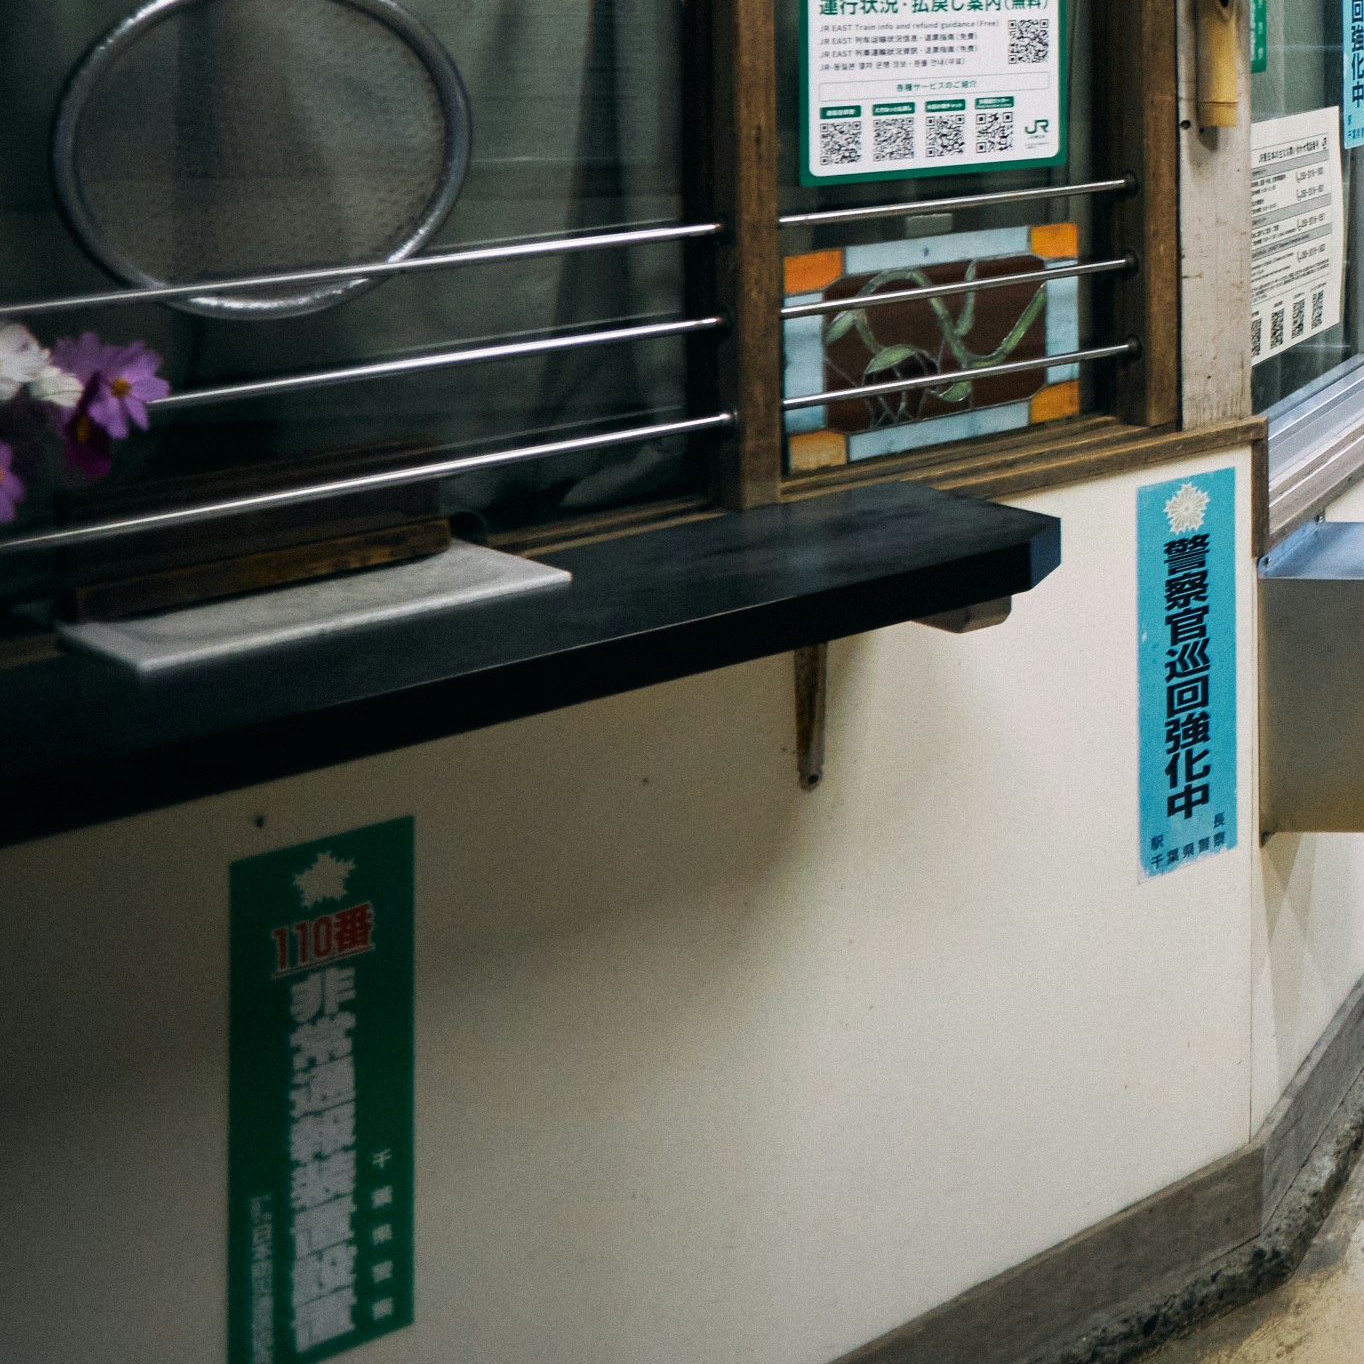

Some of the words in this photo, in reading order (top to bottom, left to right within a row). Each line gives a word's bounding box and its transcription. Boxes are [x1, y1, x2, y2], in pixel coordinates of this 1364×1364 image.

[820, 24, 830, 32] JR
[832, 23, 852, 32] EAST
[855, 22, 875, 31] Train
[878, 21, 893, 30] info
[896, 21, 910, 30] and
[912, 20, 938, 29] refund
[941, 20, 976, 30] guidance
[832, 36, 852, 45] EAST
[832, 49, 852, 58] EAST
[896, 79, 977, 92] 各種サービスのご紹介
[1025, 119, 1049, 134] JR
[1163, 532, 1211, 820] 警察官巡回強化中
[271, 901, 374, 972] 110番
